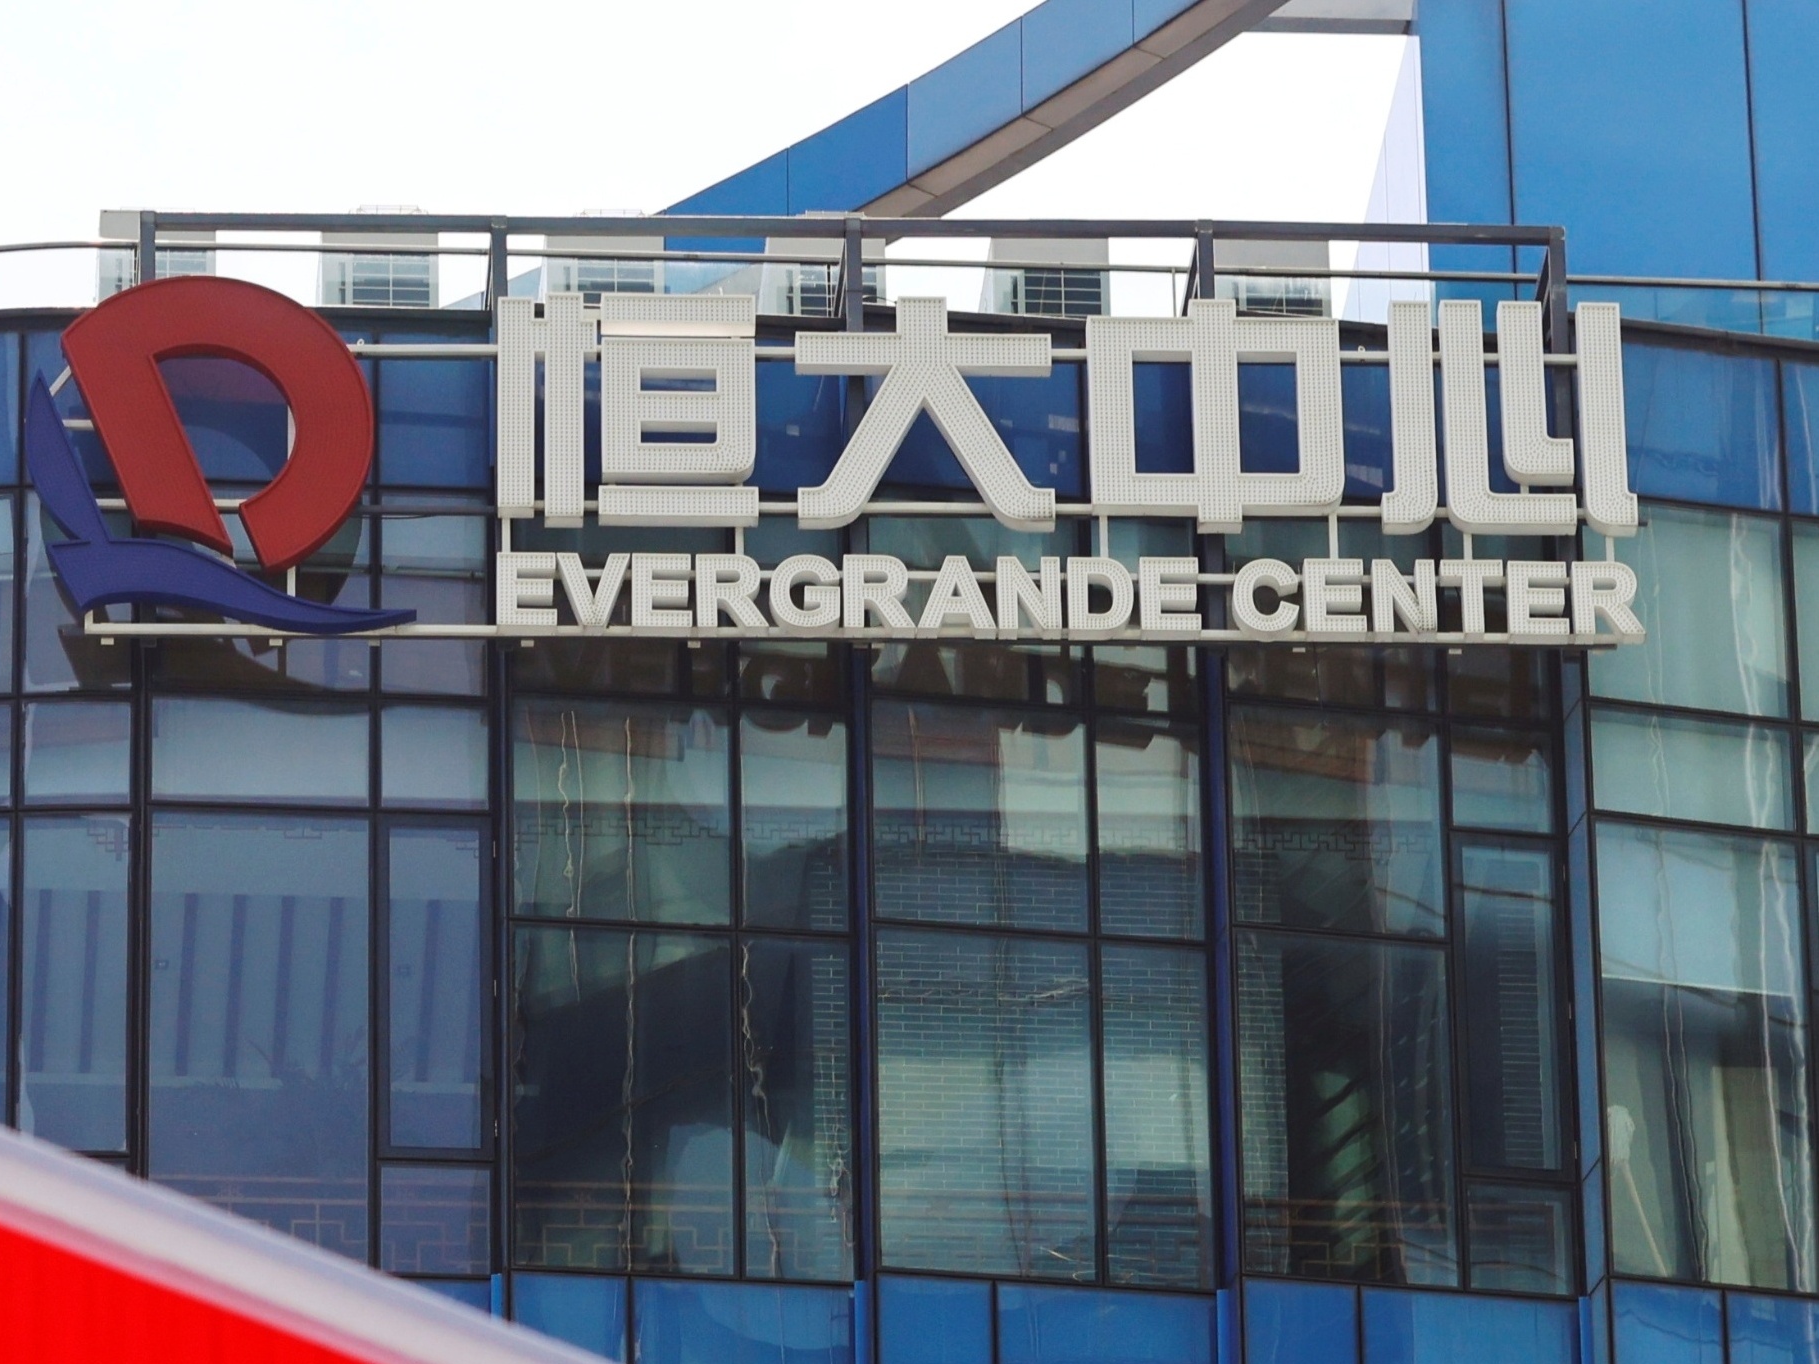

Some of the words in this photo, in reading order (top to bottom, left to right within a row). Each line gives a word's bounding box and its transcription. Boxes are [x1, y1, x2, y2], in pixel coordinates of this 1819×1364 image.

[497, 293, 1638, 536] 恒大中心
[496, 551, 1202, 640] EVERGRANDE
[1232, 558, 1646, 645] CENTER
